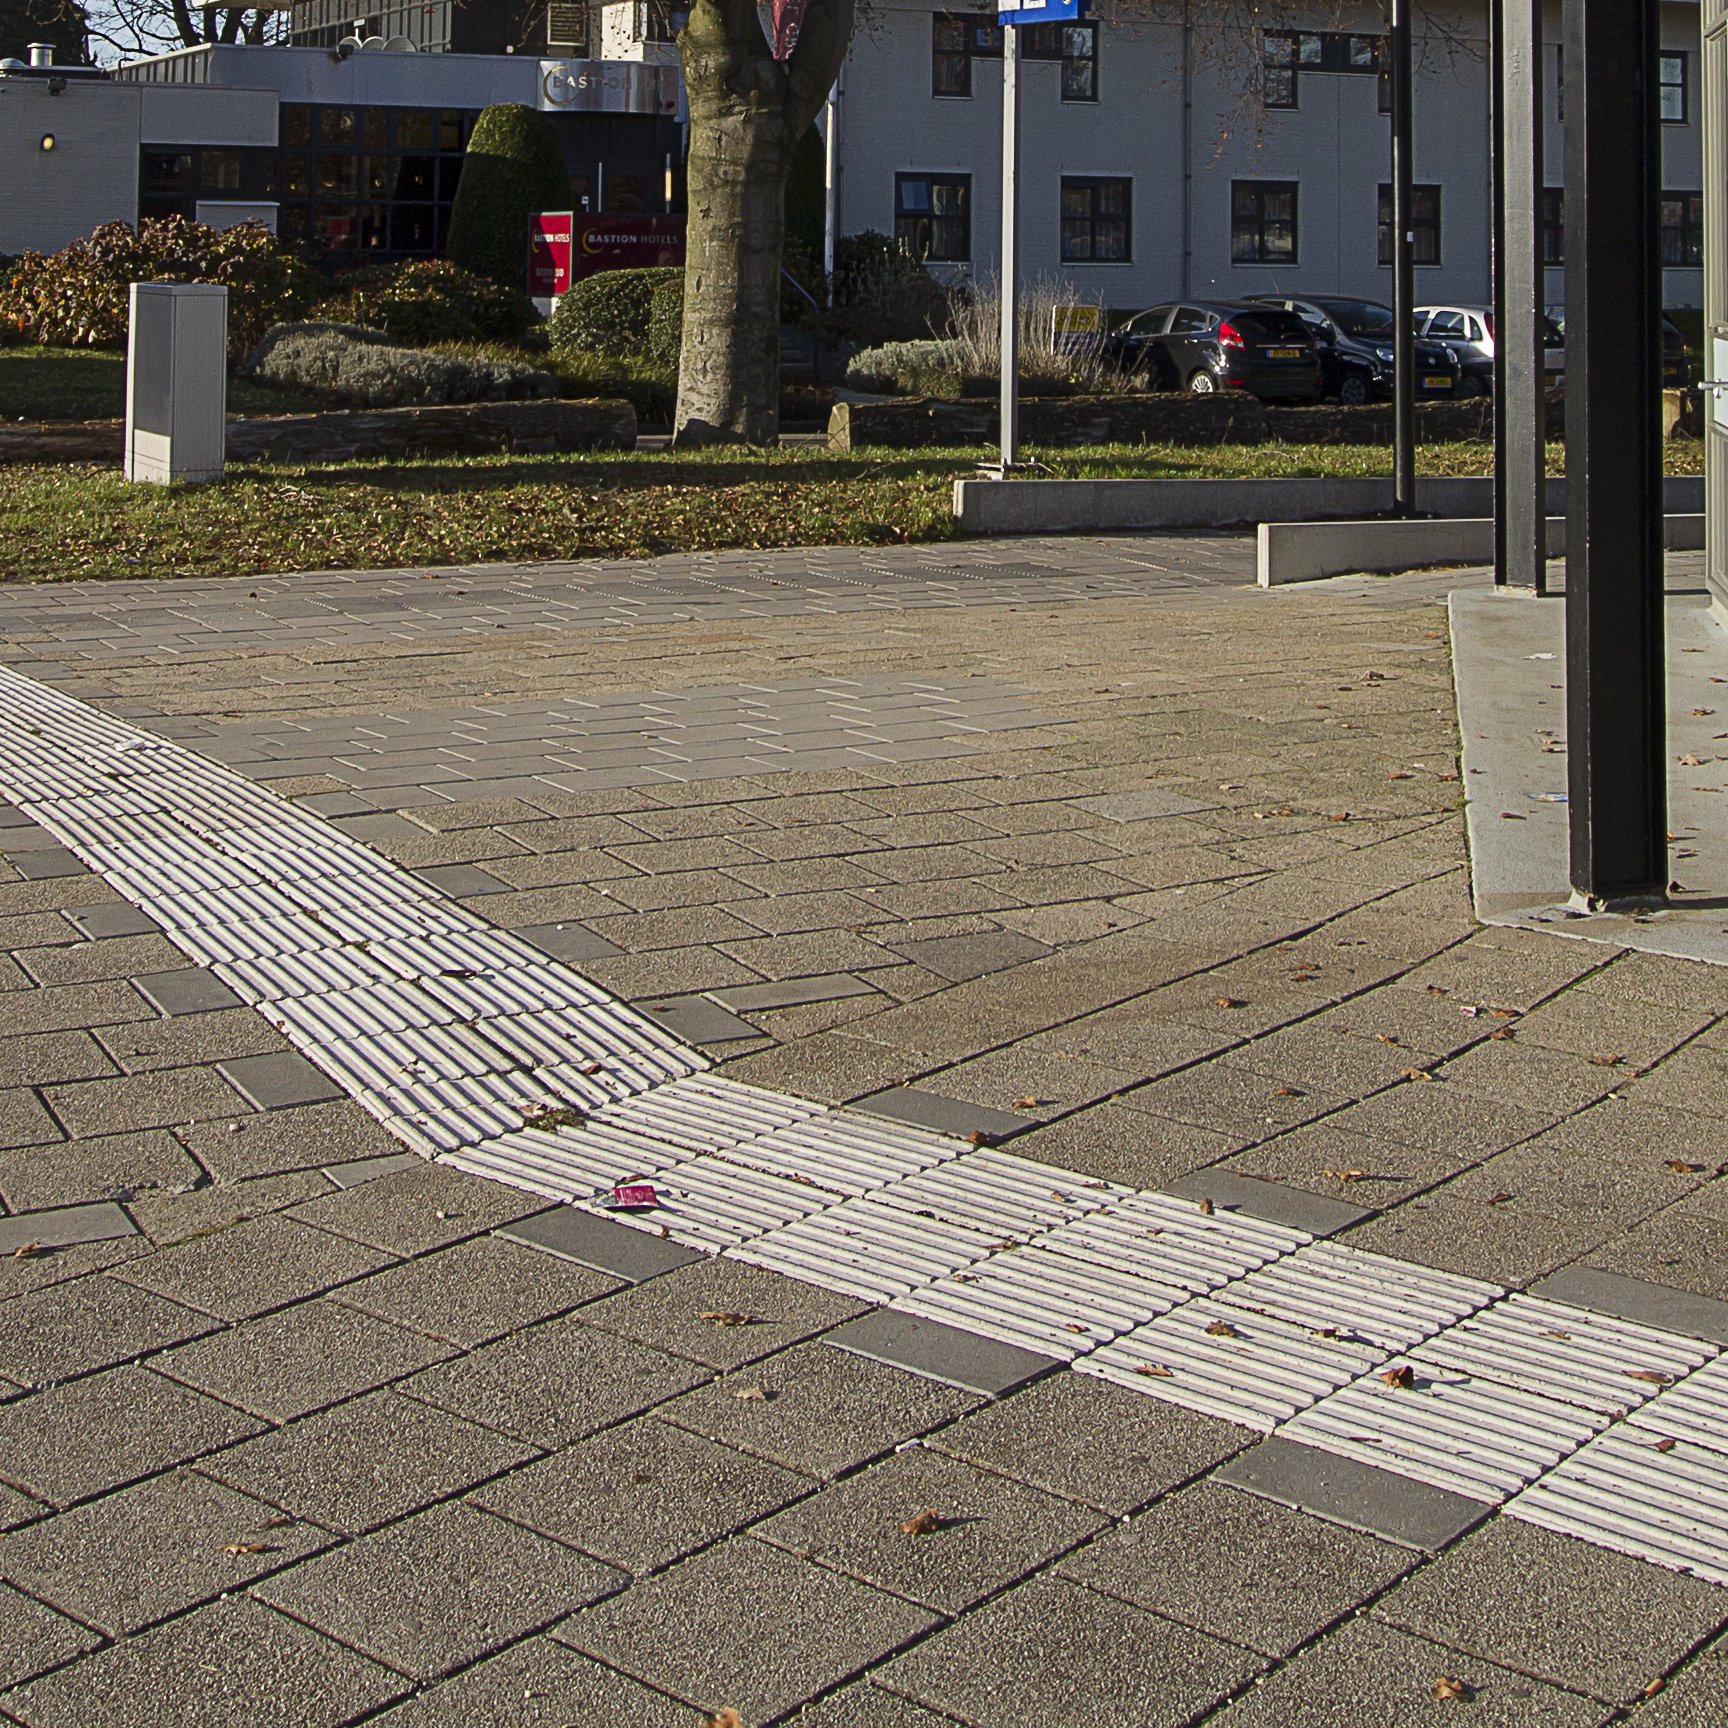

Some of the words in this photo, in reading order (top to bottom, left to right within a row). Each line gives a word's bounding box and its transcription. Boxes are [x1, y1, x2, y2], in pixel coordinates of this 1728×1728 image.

[553, 75, 626, 89] BASTO
[588, 234, 637, 243] BASTION
[640, 234, 678, 244] HOTELS
